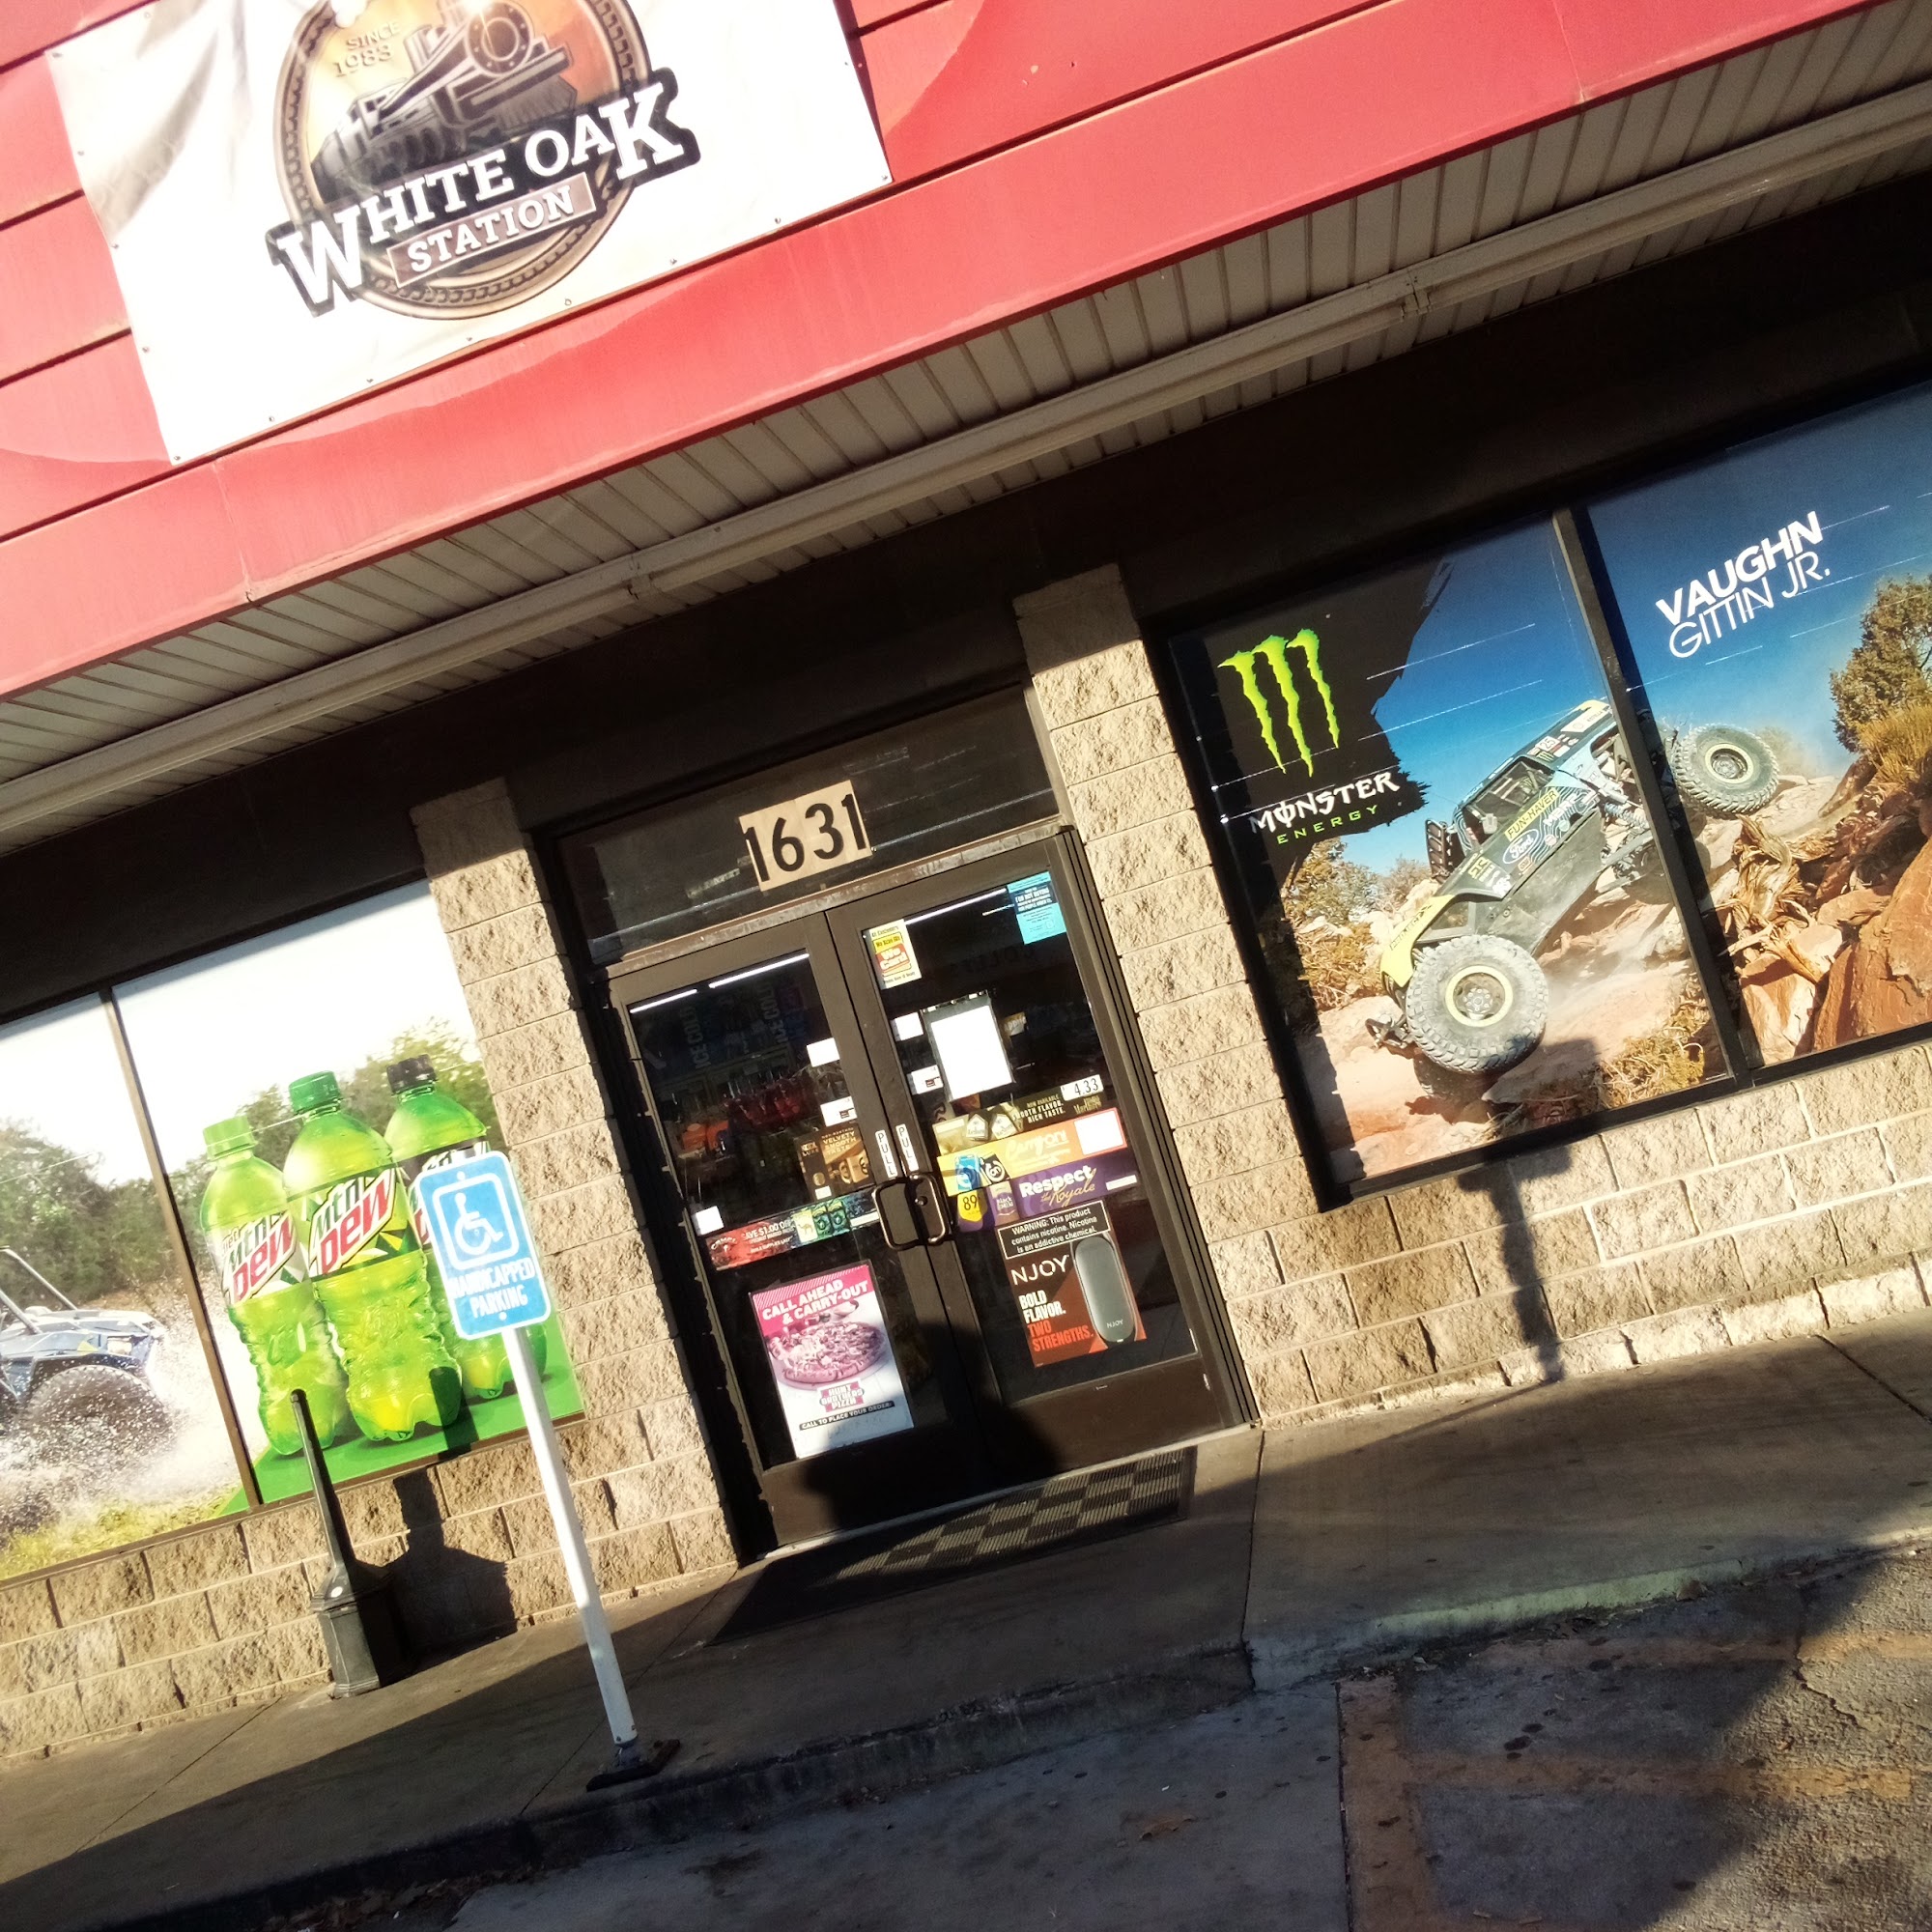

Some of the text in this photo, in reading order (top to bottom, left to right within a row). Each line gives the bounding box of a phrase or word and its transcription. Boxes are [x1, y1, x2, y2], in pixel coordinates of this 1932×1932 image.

[346, 21, 400, 50] SINCE
[334, 43, 394, 78] 1983
[277, 81, 683, 306] WHITE OAK
[409, 185, 574, 272] STATION
[1656, 511, 1824, 626] VAUGHN
[1669, 552, 1831, 658] GITTIN JR.
[1248, 772, 1401, 834] MONSTER
[1507, 790, 1558, 838] FUN-HAVER
[744, 793, 867, 882] 1631
[1276, 805, 1378, 845] ENERGY
[1509, 835, 1535, 859] Ford
[880, 947, 901, 960] We
[880, 951, 908, 970] Card
[1074, 1077, 1099, 1096] 4.33
[823, 1131, 855, 1144] VELVETY
[824, 1137, 857, 1150] SMOOTH
[898, 1126, 916, 1169] PUL
[878, 1132, 895, 1176] PULL
[1018, 1165, 1093, 1198] Respect
[1048, 1168, 1096, 1208] Royale
[741, 1228, 759, 1241] SAVE
[758, 1222, 780, 1237] $1.00
[1010, 1215, 1097, 1245] contains nicotine. Nicotine
[1011, 1208, 1091, 1236] WARNING: This product
[1017, 1226, 1096, 1254] is an addictive chemical.
[1010, 1254, 1068, 1285] NJOY
[469, 1284, 528, 1319] PARKING
[762, 1279, 843, 1321] CALL AHEAD
[782, 1280, 868, 1325] & CARRY-OUT
[1018, 1290, 1048, 1310] BOLD
[1022, 1301, 1066, 1324] FLAVOR.
[1027, 1320, 1052, 1338] TWO
[1032, 1324, 1094, 1352] STRENGTHS.
[1106, 1319, 1123, 1329] NJOY
[802, 1420, 818, 1430] CALL
[829, 1411, 849, 1423] PLACE
[849, 1406, 867, 1417] YOUR
